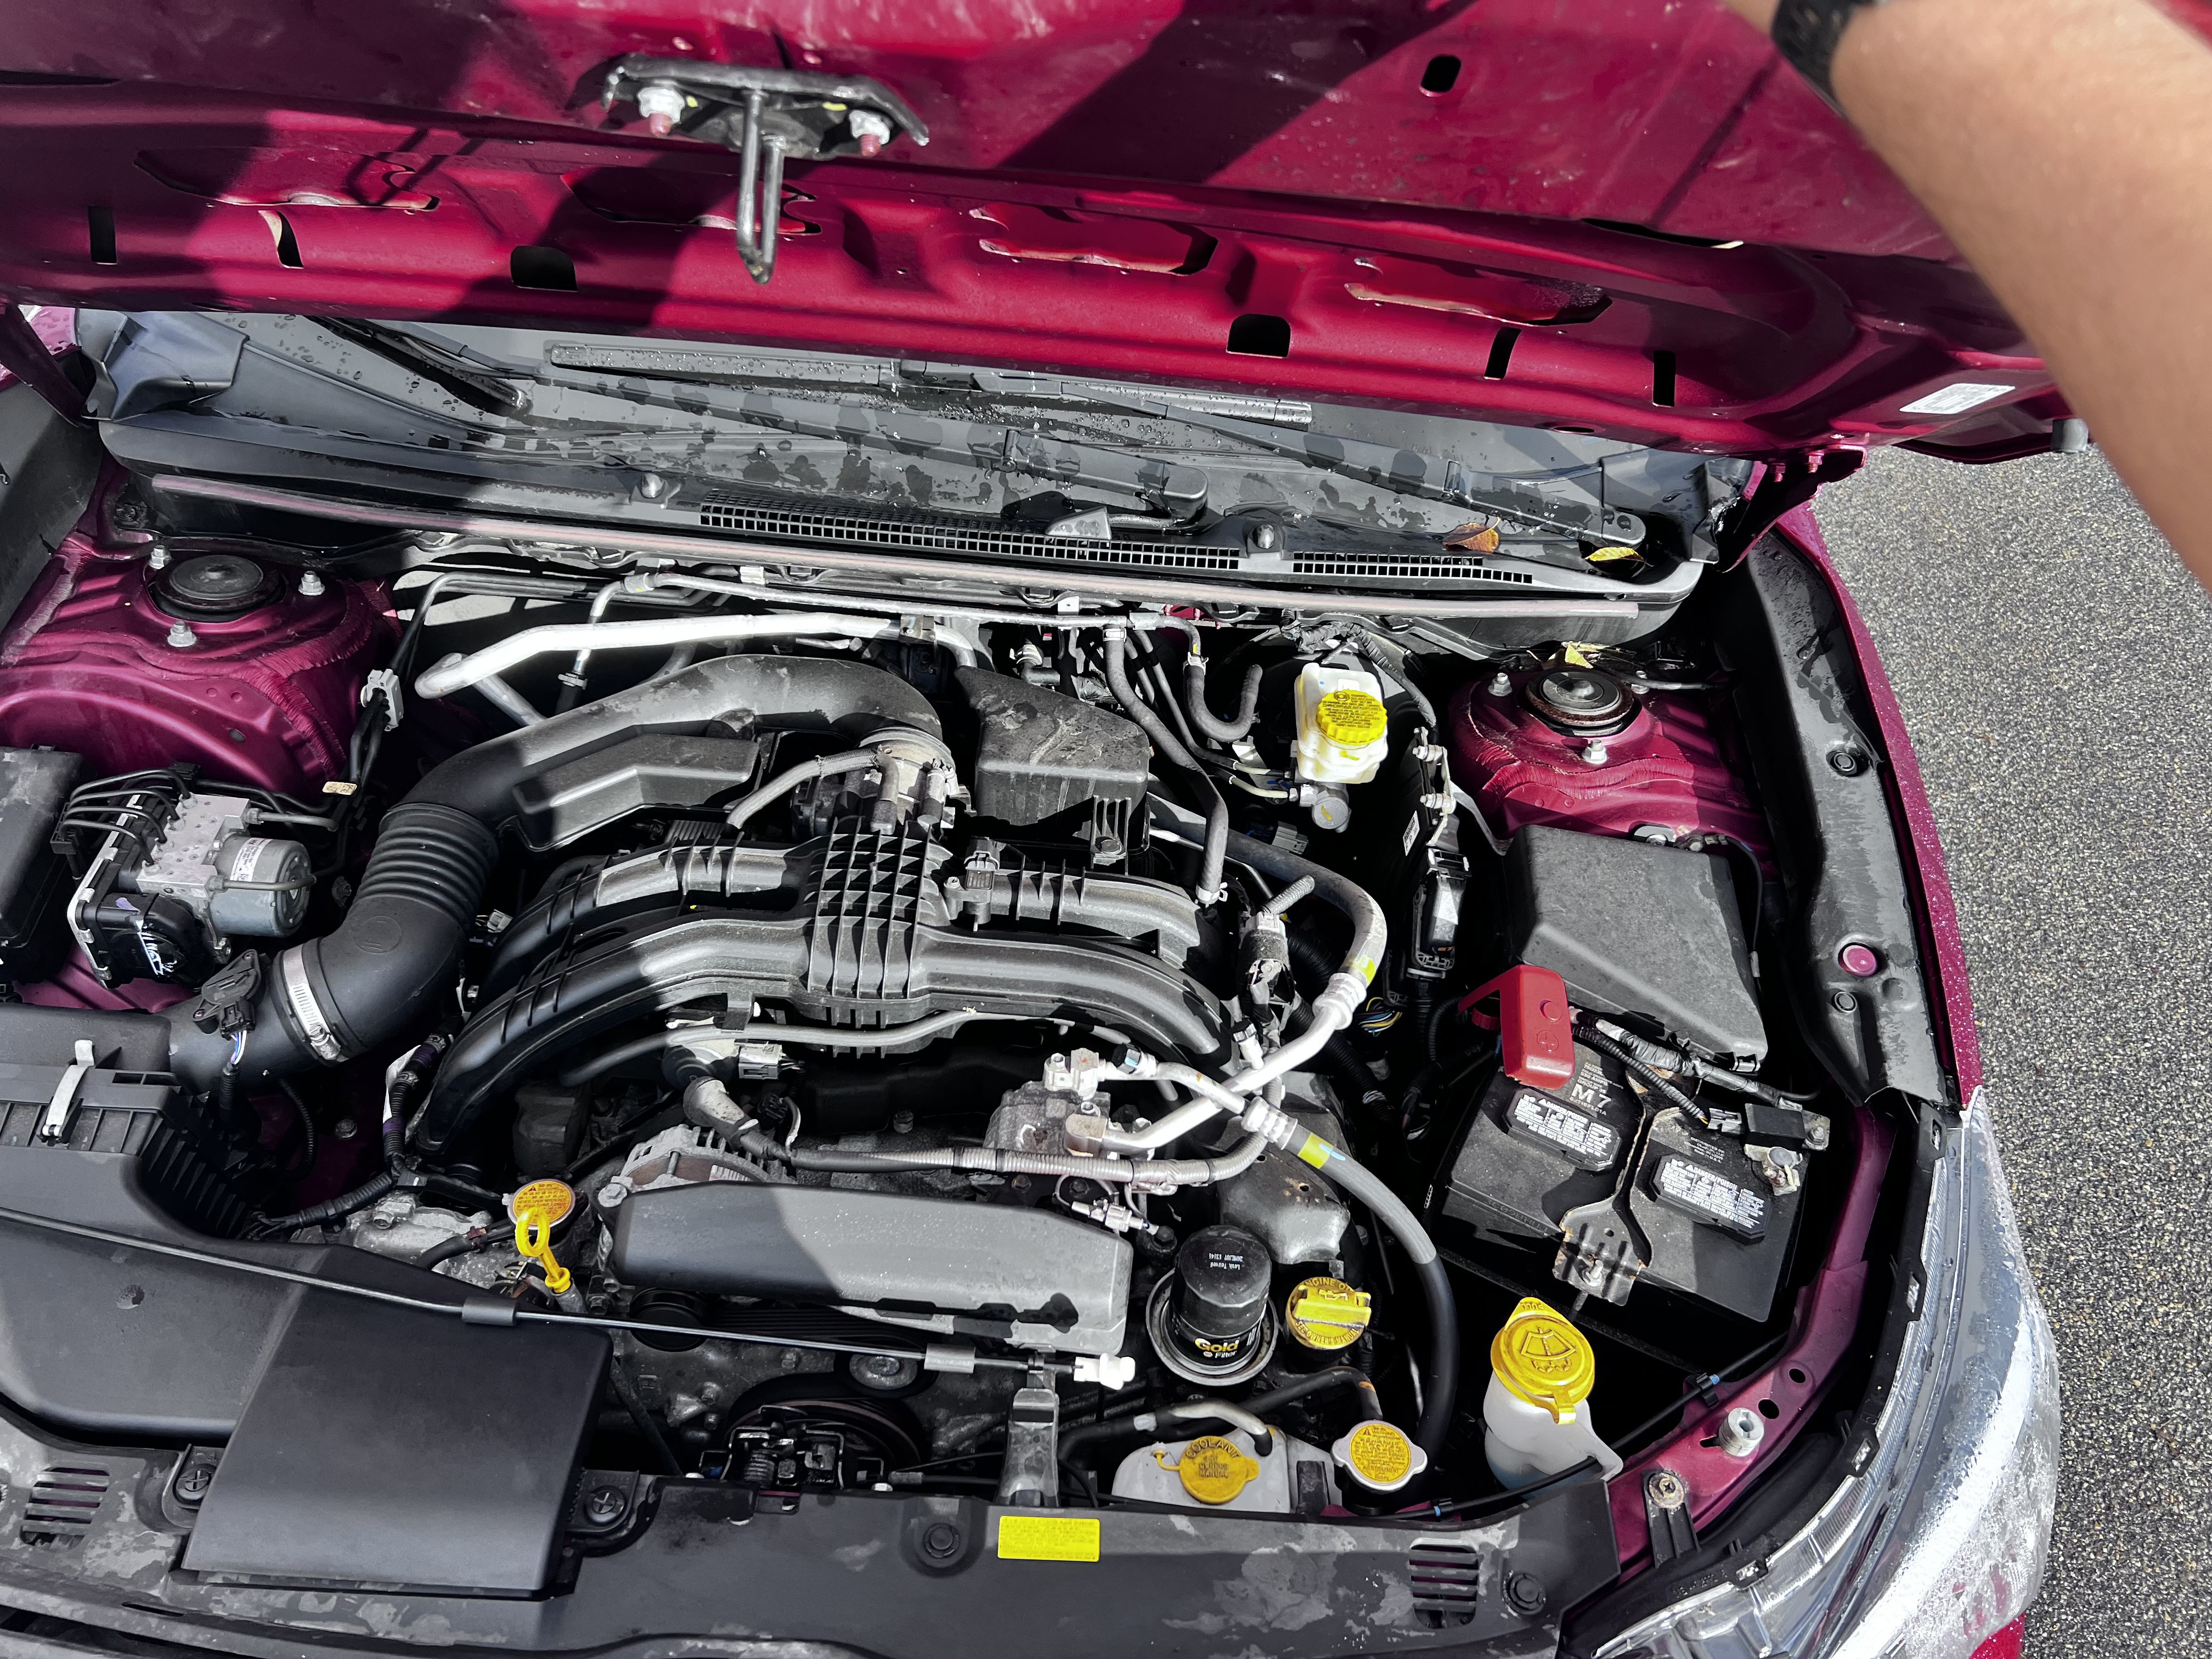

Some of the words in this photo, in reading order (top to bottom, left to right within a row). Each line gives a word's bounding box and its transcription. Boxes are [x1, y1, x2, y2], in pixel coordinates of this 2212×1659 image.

[1591, 1076, 1608, 1086] AMPS
[1694, 1167, 1739, 1190] DANGER/POISON
[1302, 1277, 1337, 1288] NGINE
[1295, 1321, 1308, 1333] SEE
[1335, 1328, 1359, 1345] MANUAL
[1195, 1338, 1239, 1352] Gold
[1186, 1437, 1241, 1459] COOLANT
[1199, 1470, 1229, 1479] MANUAL
